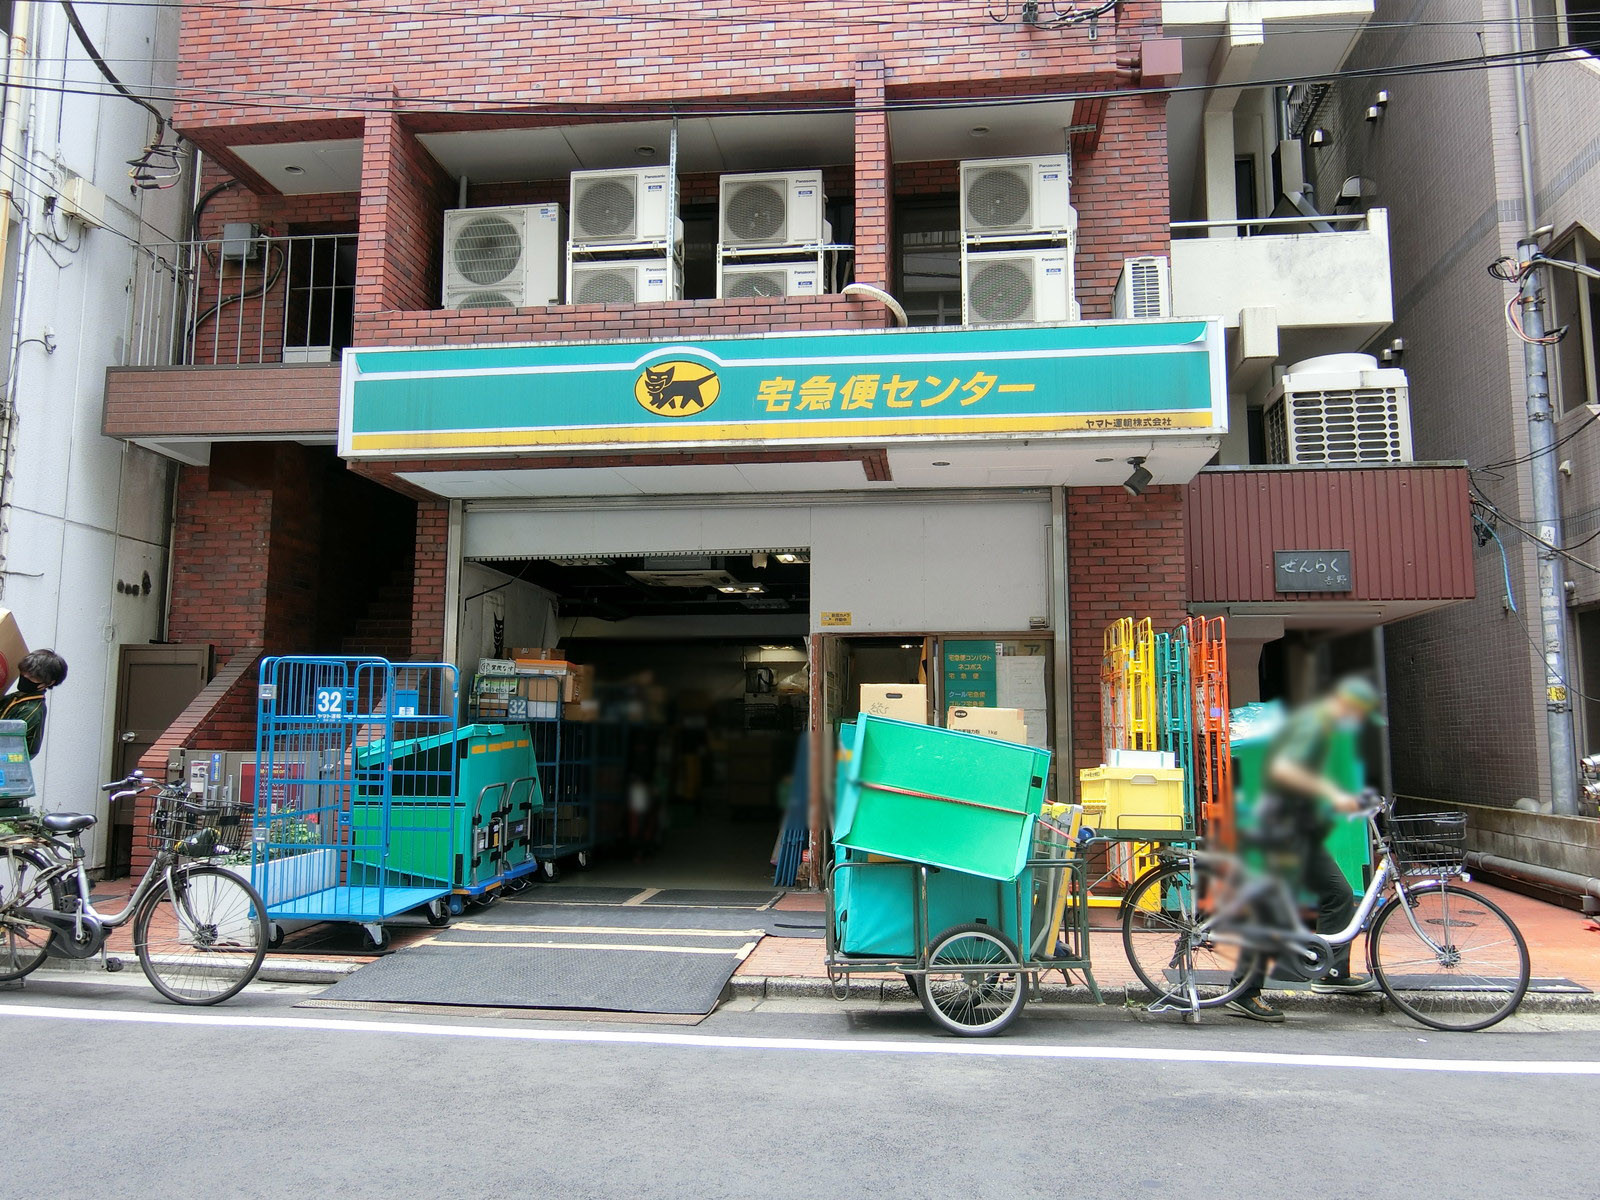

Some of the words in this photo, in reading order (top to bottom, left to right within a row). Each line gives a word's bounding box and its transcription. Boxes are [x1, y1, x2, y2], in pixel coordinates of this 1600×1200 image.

[757, 372, 1035, 412] 宅急便センター
[1086, 417, 1172, 428] ヤマト運輸株式会社
[1280, 558, 1339, 572] ぜんらく
[317, 691, 342, 712] 32
[509, 700, 527, 714] 32
